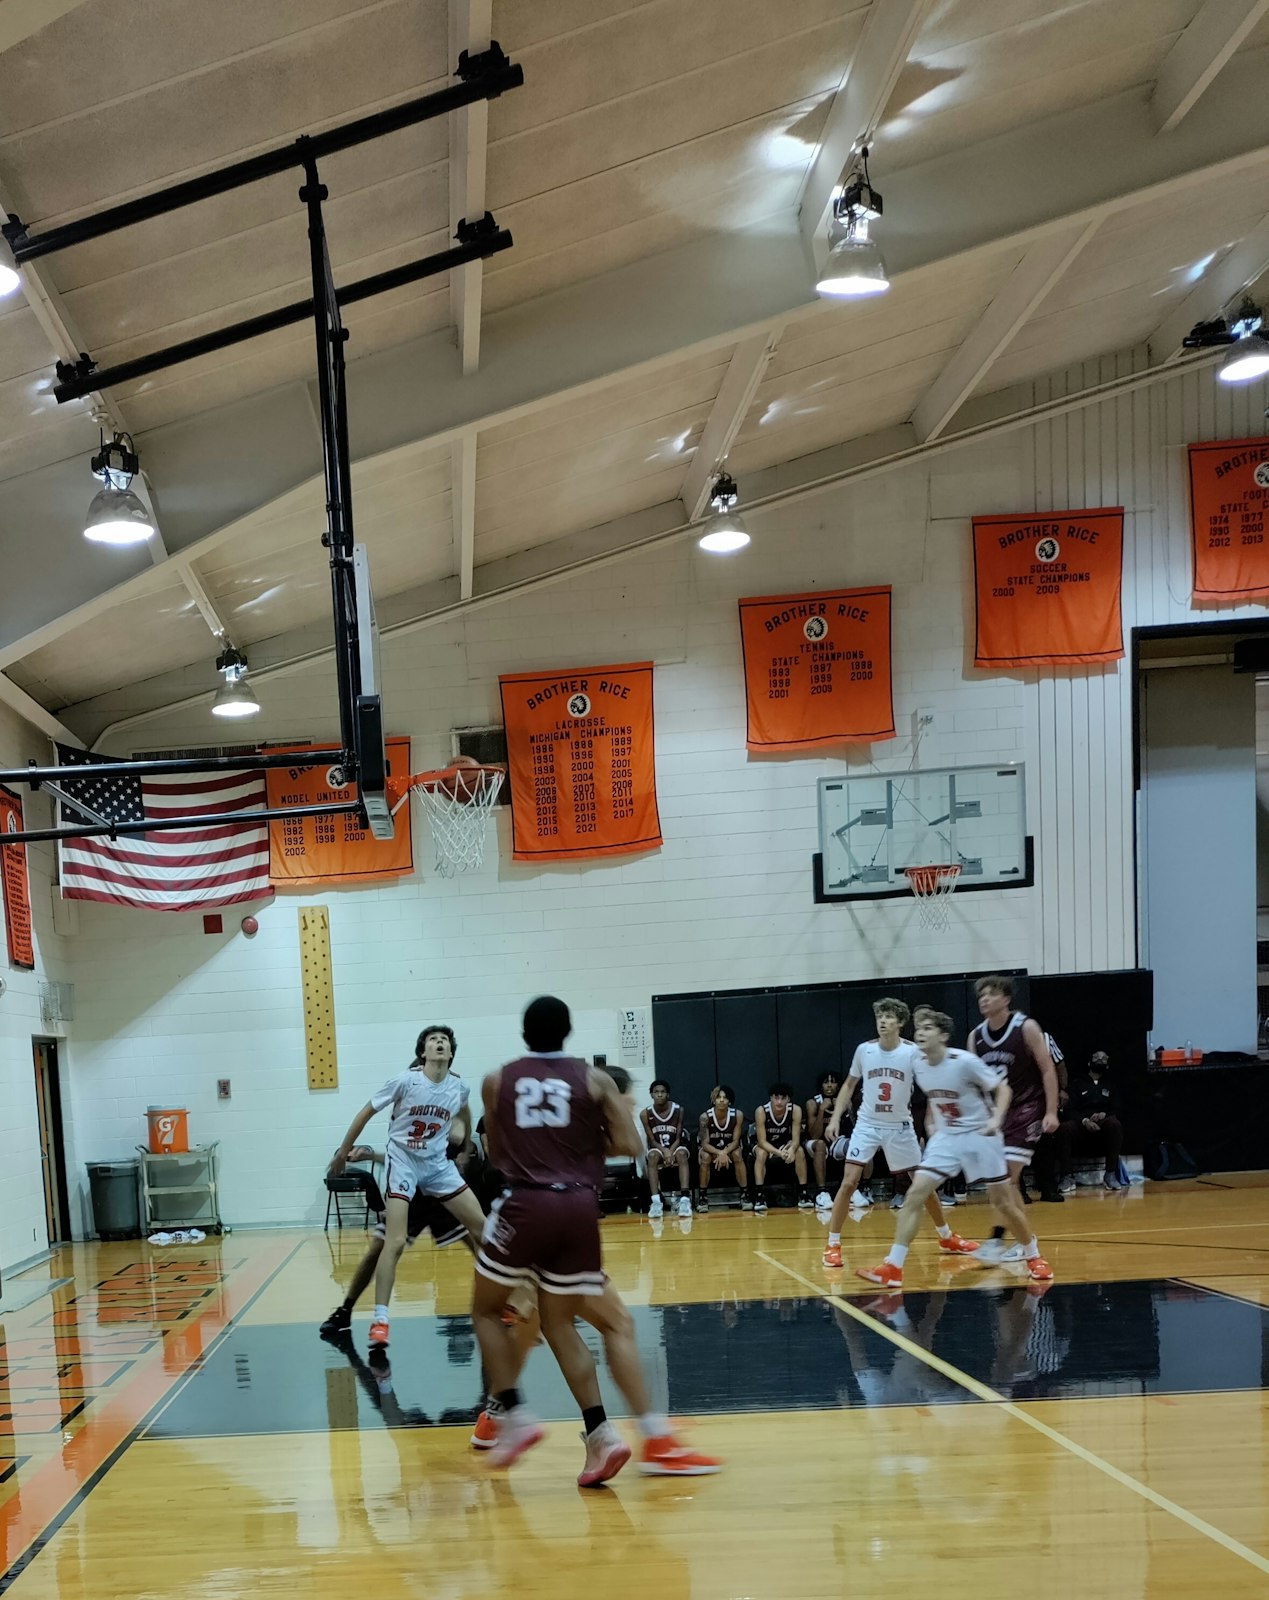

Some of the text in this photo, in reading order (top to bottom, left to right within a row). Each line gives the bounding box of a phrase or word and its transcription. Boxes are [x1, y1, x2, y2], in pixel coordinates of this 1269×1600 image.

[1220, 503, 1248, 513] STATE
[1210, 512, 1263, 525] 1974 1977
[998, 524, 1100, 548] BROTHER RICE
[1210, 523, 1264, 536] 1990 2000
[1209, 535, 1264, 548] 2012 2013
[1030, 563, 1066, 574] SOCCER
[1008, 572, 1090, 586] STATE CHAMPIONS
[992, 585, 1060, 597] 2000 2009
[764, 603, 870, 632] BROTHER RICE
[800, 642, 834, 654] TENNIS
[772, 651, 864, 666] STATE CHAMPIONS
[768, 668, 790, 677] 1983
[769, 671, 872, 688] 1998 1999 2000
[527, 680, 630, 710] BROTHER RICE
[768, 685, 832, 698] 2001 2009
[556, 717, 606, 730] LACROSSE
[530, 726, 632, 744] MICHIGAN CHAMPIONS
[532, 744, 554, 754] 1986
[611, 737, 632, 746] 1989
[533, 747, 632, 764] 1990 1996 1997
[534, 760, 630, 775] 1998 2000 2001
[534, 769, 632, 786] 2003 2004 2005
[536, 780, 632, 796] 2006 2007 2008
[281, 790, 350, 804] MODEL UNITED
[536, 788, 632, 806] 2009 2010 2011
[536, 798, 634, 816] 2012 2013 2014
[344, 812, 358, 821] 197
[537, 808, 634, 826] 2015 2016 2017
[283, 822, 359, 836] 1982 1986 199
[538, 824, 596, 836] 2019 2021
[284, 832, 366, 846] 1992 1998 2000
[284, 847, 306, 856] 2002
[626, 1012, 634, 1021] E
[868, 1068, 905, 1082] BROTHER
[878, 1082, 892, 1102] 3
[408, 1104, 450, 1122] BROTHER
[875, 1104, 894, 1112] RICE
[159, 1117, 172, 1132] G
